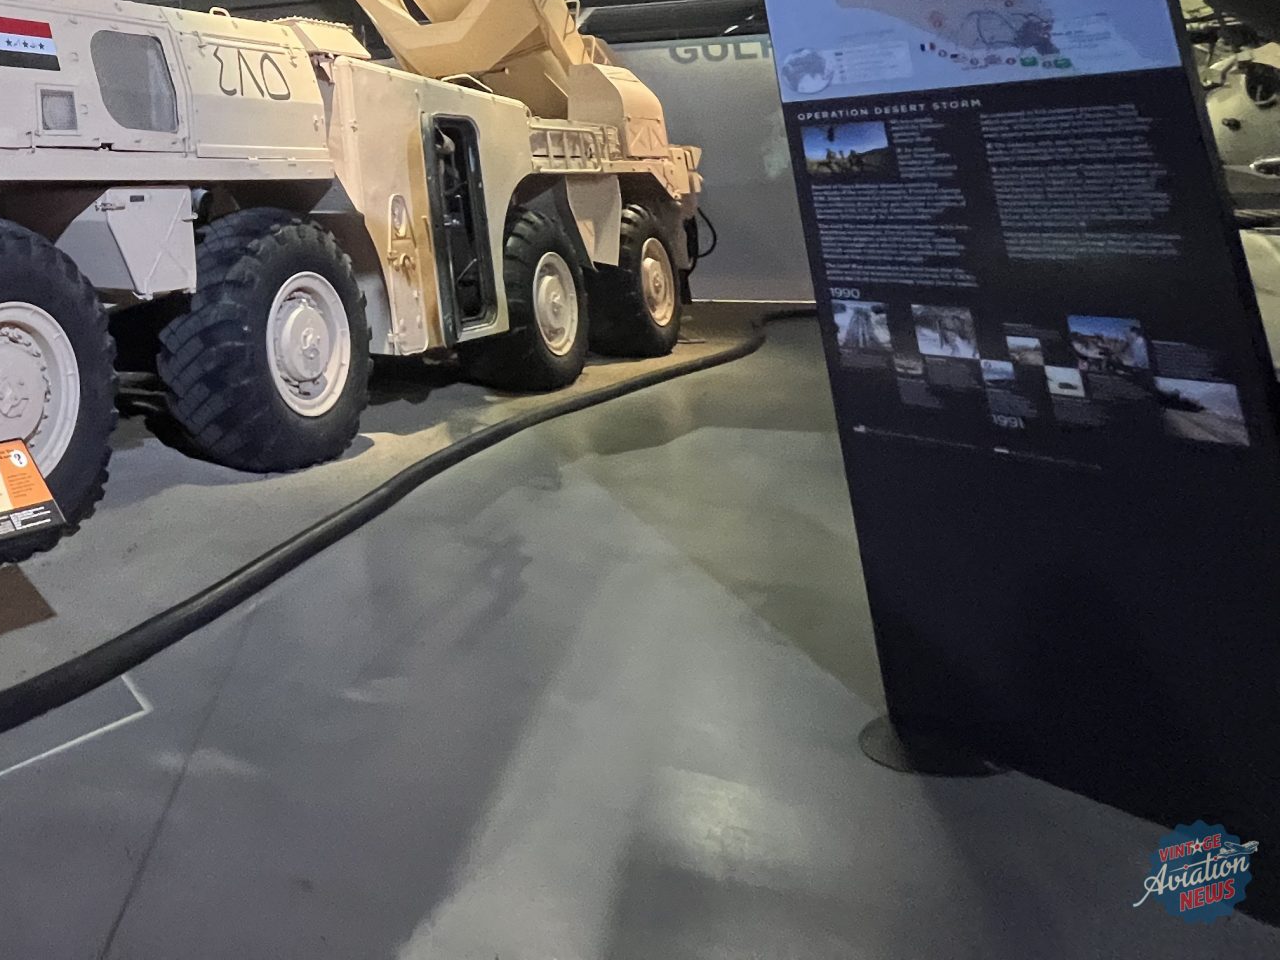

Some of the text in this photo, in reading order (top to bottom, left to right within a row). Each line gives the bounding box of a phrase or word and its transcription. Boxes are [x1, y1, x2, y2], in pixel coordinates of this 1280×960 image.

[797, 99, 982, 121] OPERATION DESERT STORM
[829, 287, 861, 300] 1990
[991, 414, 1025, 429] 1991
